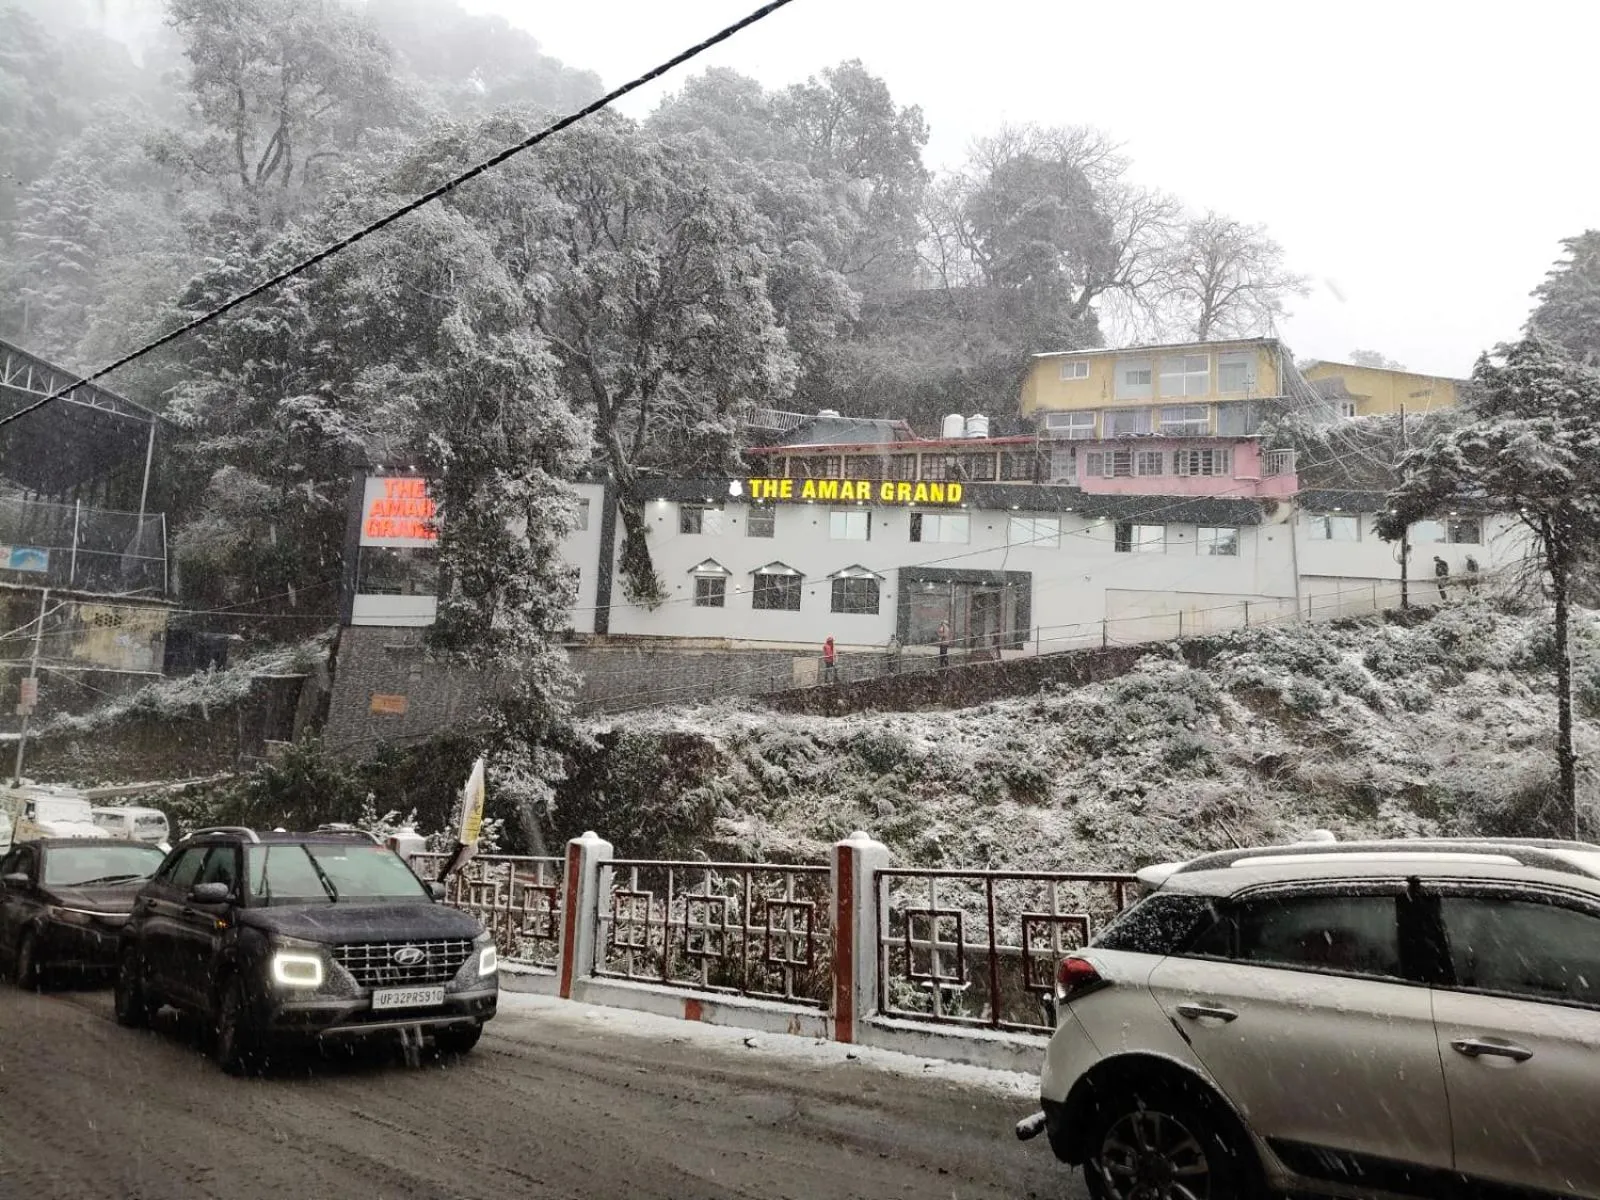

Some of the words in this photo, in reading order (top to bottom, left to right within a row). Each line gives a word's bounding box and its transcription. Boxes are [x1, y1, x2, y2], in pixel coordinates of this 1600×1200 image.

[384, 479, 426, 498] THE
[749, 479, 793, 498] THE
[802, 480, 871, 500] AMAR
[880, 482, 962, 502] GRAND
